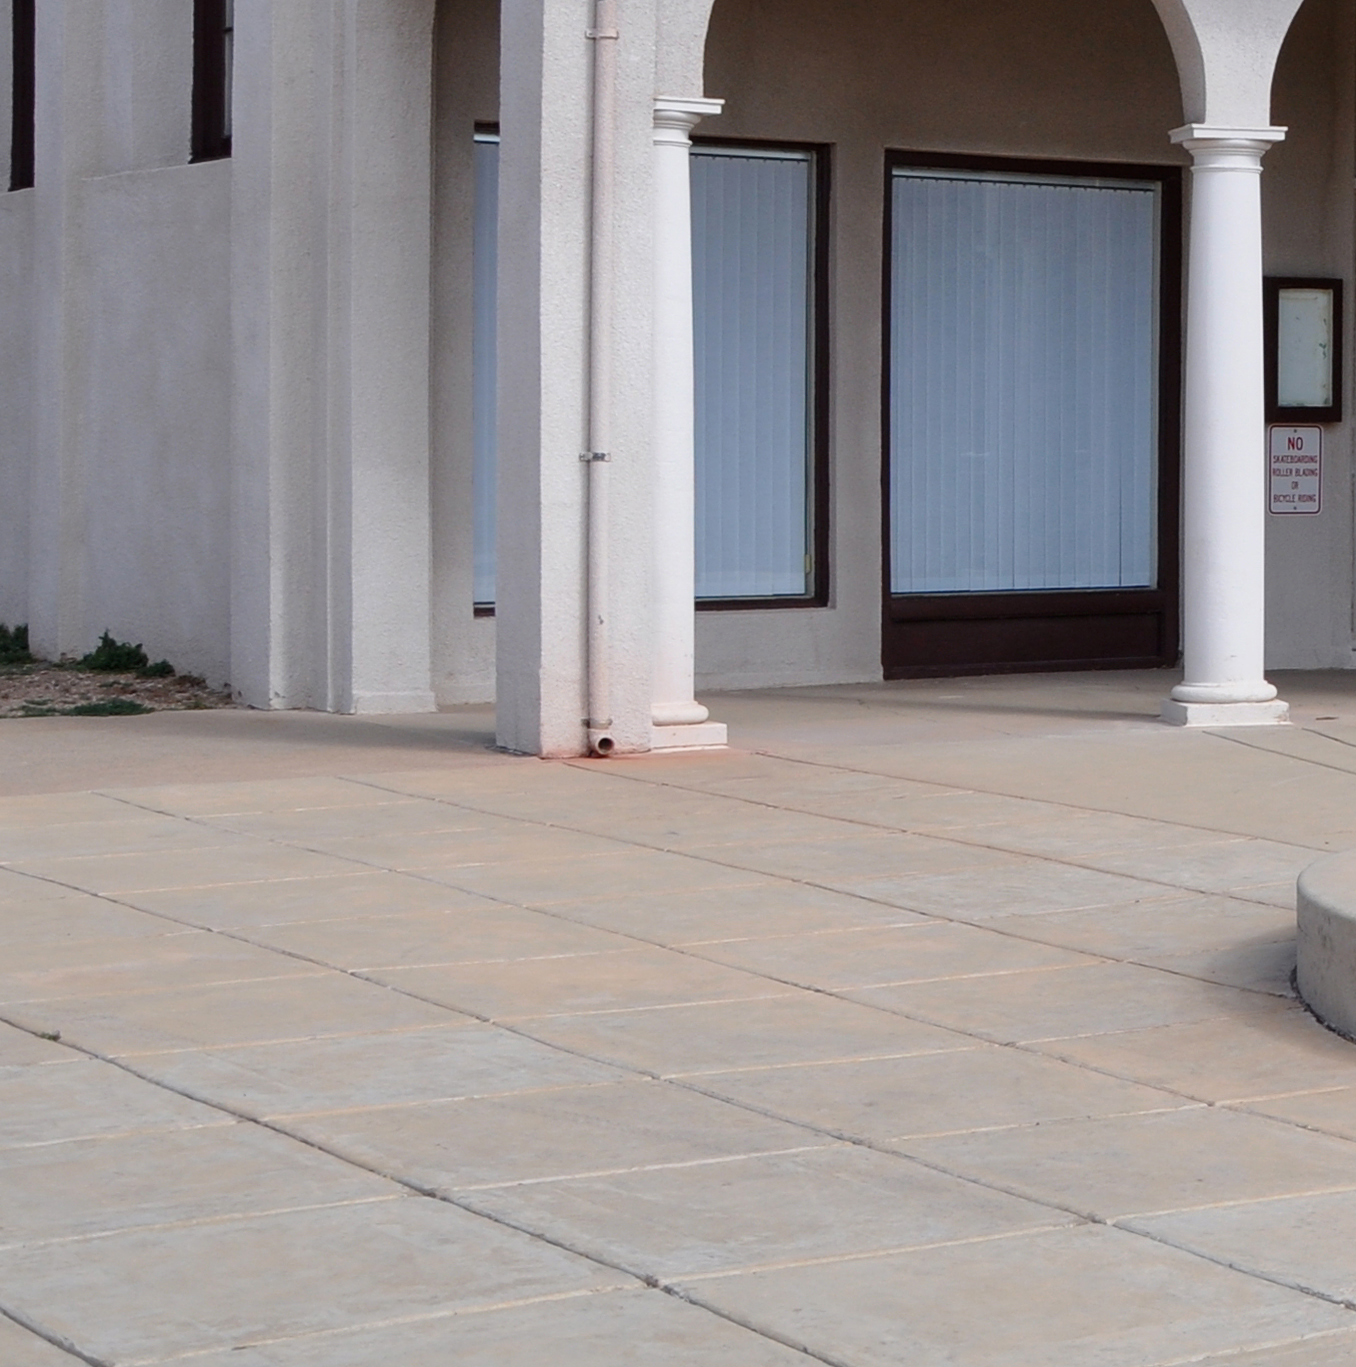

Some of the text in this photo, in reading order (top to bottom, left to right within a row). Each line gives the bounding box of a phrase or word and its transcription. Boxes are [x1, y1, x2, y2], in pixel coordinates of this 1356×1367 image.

[1287, 436, 1304, 451] NO
[1272, 455, 1318, 464] SKATEBOARDING
[1272, 468, 1318, 477] ROLLER BLADING
[1291, 481, 1299, 490] OR
[1273, 494, 1317, 503] BICYCLE RIDING
